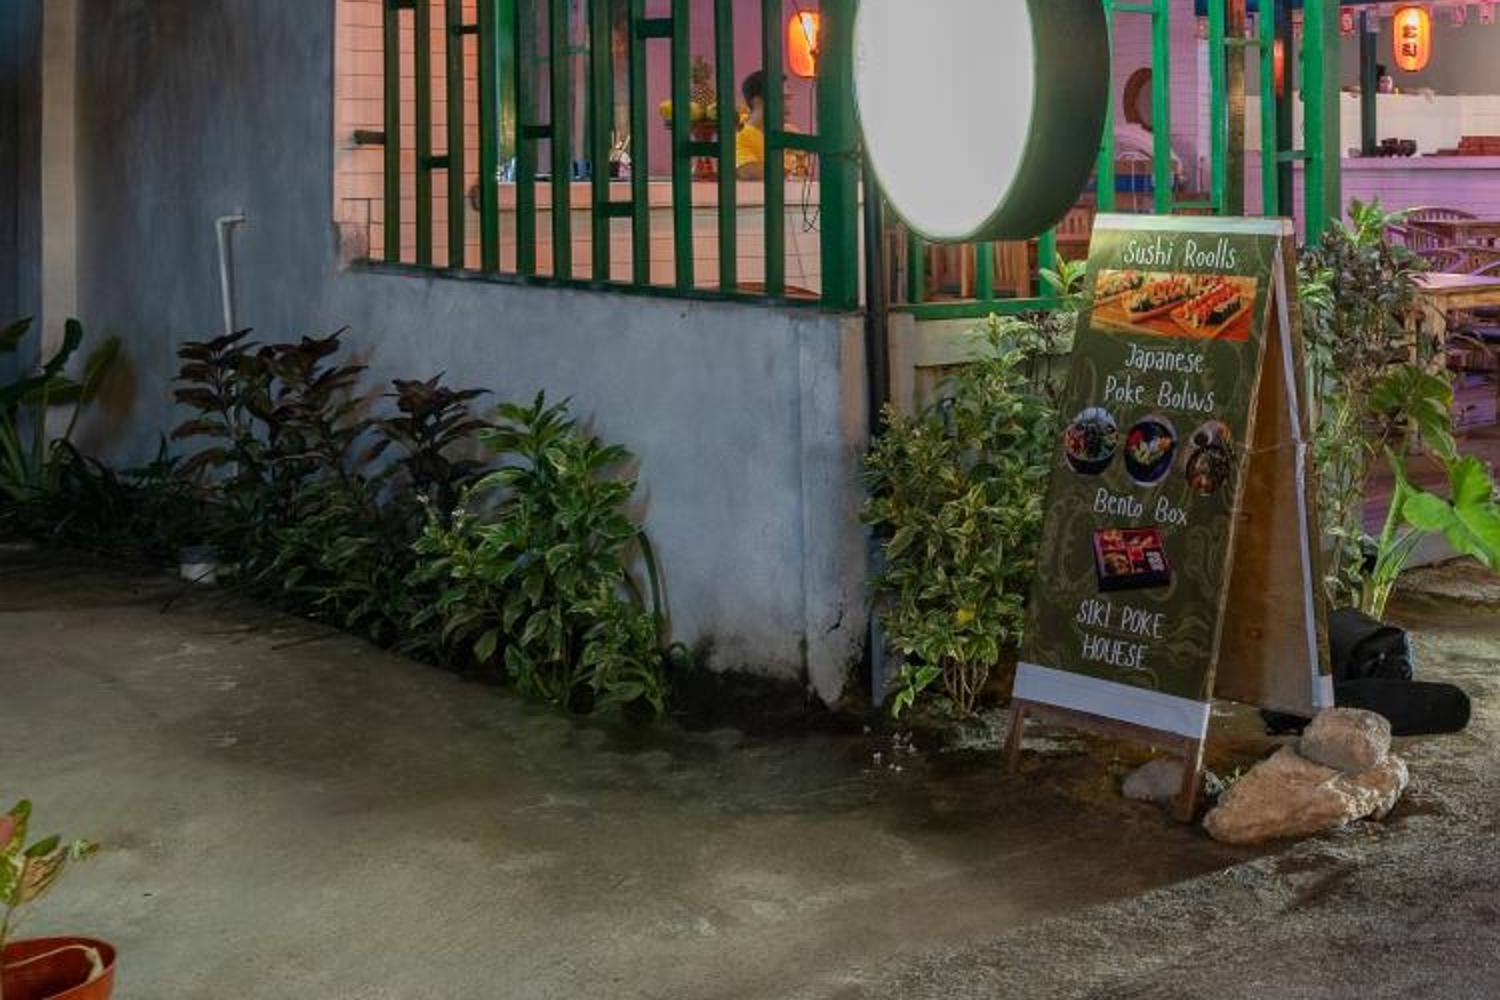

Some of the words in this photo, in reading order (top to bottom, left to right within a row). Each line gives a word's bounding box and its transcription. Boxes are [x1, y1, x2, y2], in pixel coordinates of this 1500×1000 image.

[1123, 235, 1174, 265] Sushi
[1184, 237, 1237, 269] Roolls
[1125, 343, 1204, 374] Japanese
[1103, 374, 1145, 404] Poke
[1157, 378, 1215, 413] Bolws
[1093, 487, 1143, 518] Bento
[1154, 495, 1188, 526] Box
[1075, 599, 1112, 628] SIKI
[1120, 605, 1167, 639] POKE
